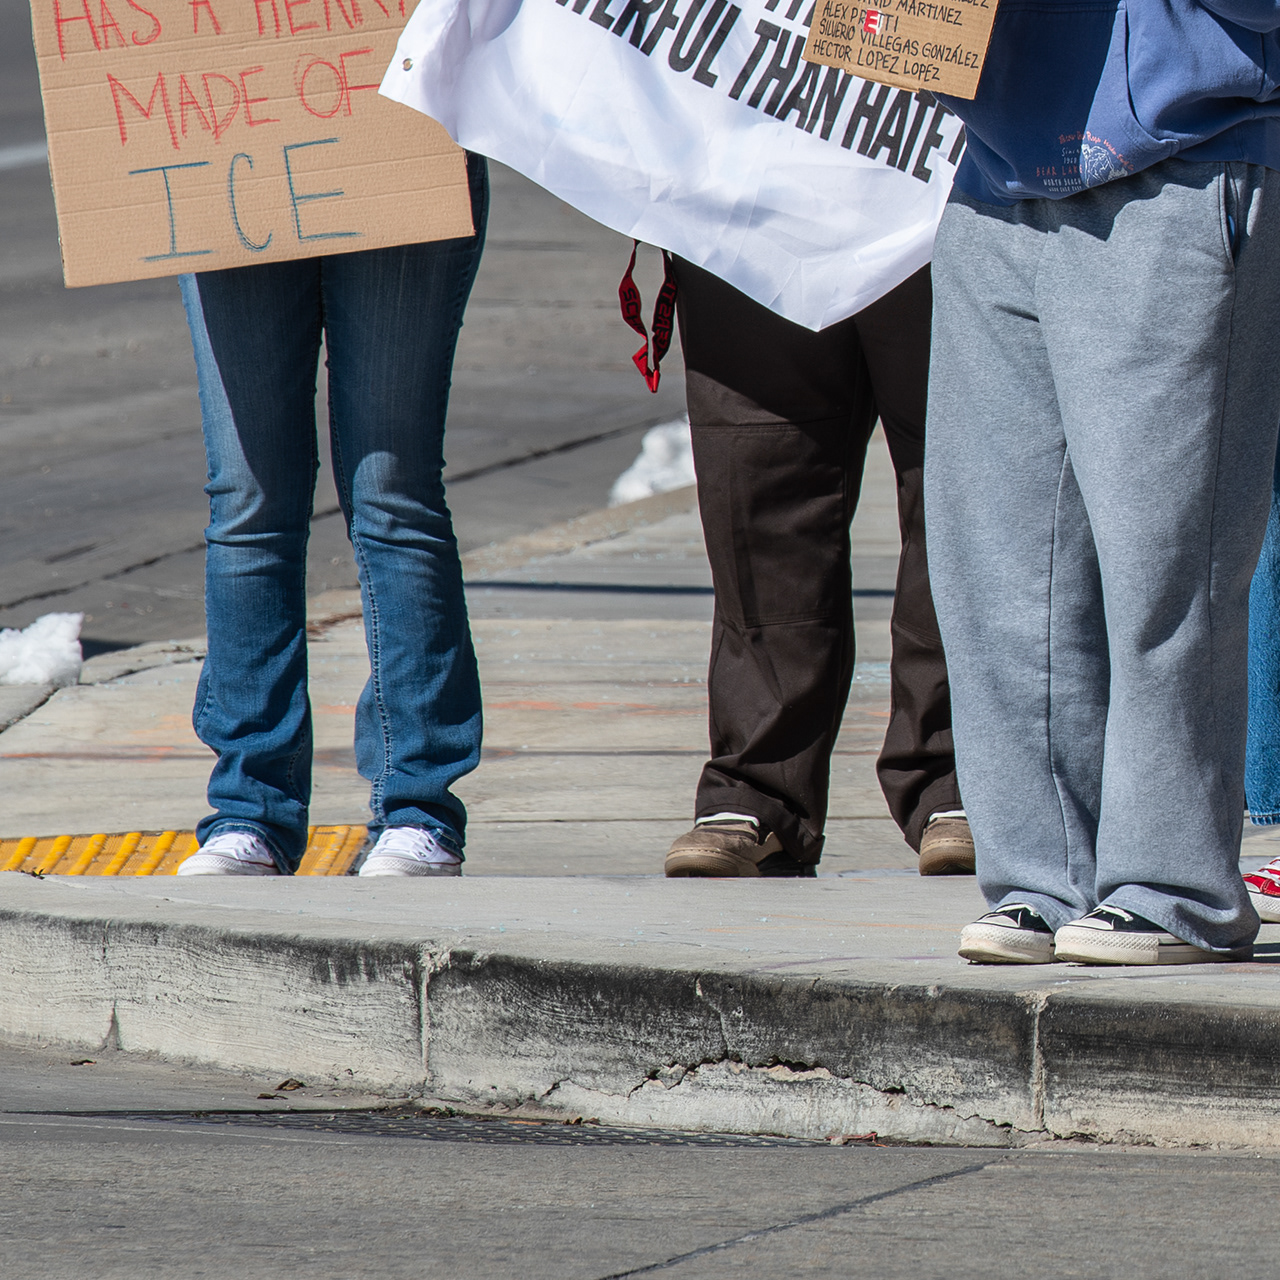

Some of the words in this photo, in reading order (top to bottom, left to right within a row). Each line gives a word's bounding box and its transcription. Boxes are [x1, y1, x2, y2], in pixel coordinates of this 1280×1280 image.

[822, 0, 849, 22] ALEX
[896, 0, 963, 27] MARTINEZ
[819, 18, 856, 42] SILVERIO
[860, 29, 920, 57] VILLEGAS
[812, 40, 852, 62] HECTOR
[858, 48, 900, 76] LOPEZ
[903, 60, 940, 82] LOPEZ
[107, 65, 280, 150] MADE
[295, 48, 379, 119] OF
[729, 17, 852, 143] THAN
[840, 76, 955, 184] HATE
[127, 137, 364, 263] ICE
